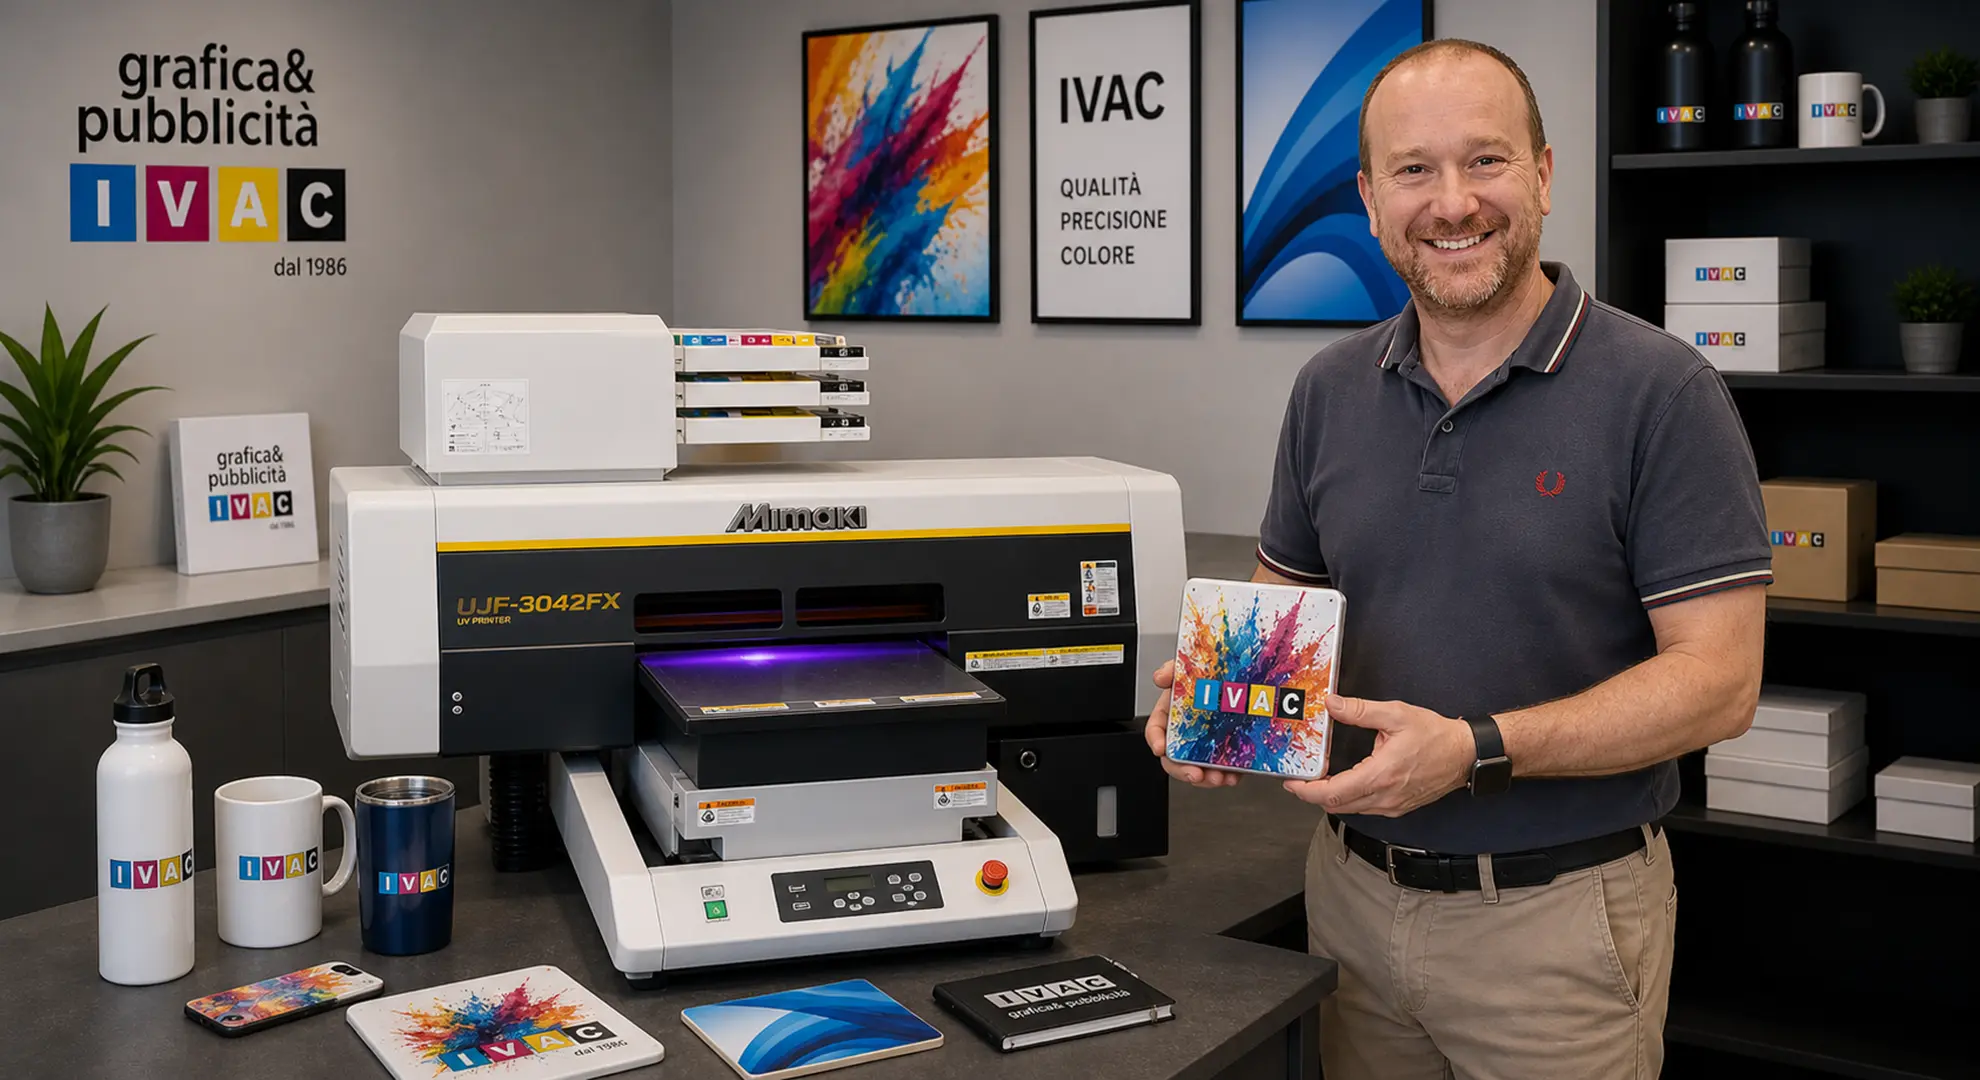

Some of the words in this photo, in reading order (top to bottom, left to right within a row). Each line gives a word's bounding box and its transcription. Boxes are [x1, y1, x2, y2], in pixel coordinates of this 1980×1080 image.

[117, 43, 316, 101] grafica&
[1059, 70, 1166, 124] IVAC
[1660, 108, 1703, 121] IVAC
[1737, 104, 1781, 118] IVAC
[1814, 104, 1856, 116] IVAC
[77, 95, 319, 153] pubblicità
[1060, 172, 1142, 200] QUALITÀ
[94, 176, 337, 231] IVAC
[1060, 209, 1168, 231] PRECISIONE
[273, 256, 301, 277] dal
[305, 256, 347, 277] 1986
[1060, 245, 1136, 266] COLORE
[1698, 268, 1745, 280] IVAC
[1698, 333, 1745, 345] IVAC
[216, 444, 284, 471] grafica&
[207, 464, 287, 493] pubblicità
[214, 494, 291, 518] IVAC
[1774, 531, 1823, 546] IVAC
[456, 591, 622, 616] UJF-3042FX
[456, 616, 473, 626] UV
[1202, 682, 1302, 717] IVAC
[116, 853, 194, 885] IVAC
[245, 850, 318, 877] IVAC
[384, 867, 449, 891] IVAC
[995, 976, 1109, 1006] IVAC
[454, 1023, 606, 1068] IVAC
